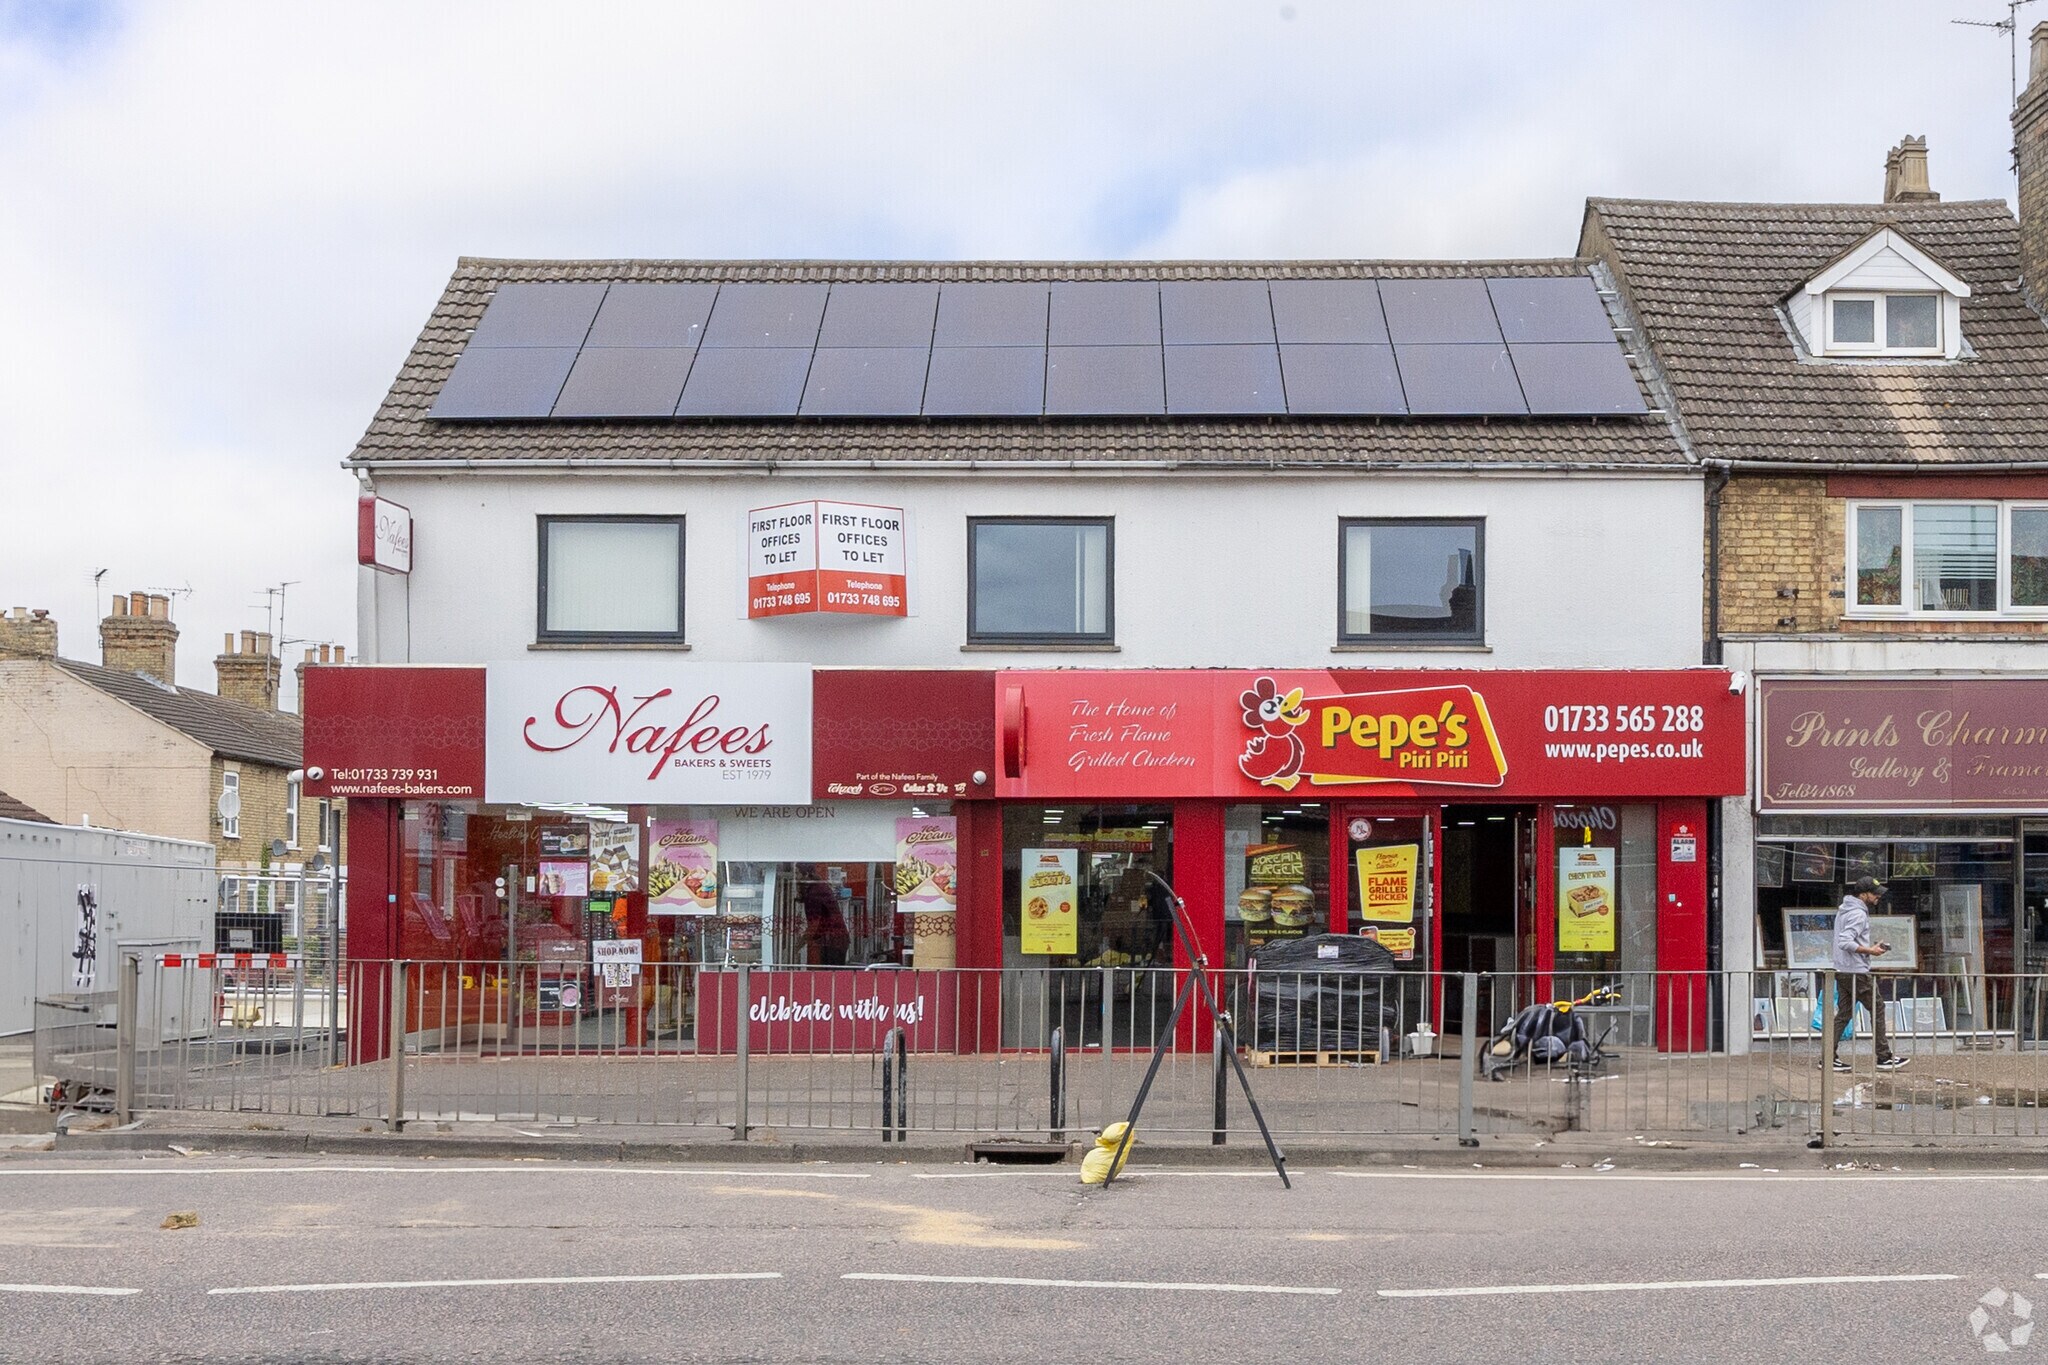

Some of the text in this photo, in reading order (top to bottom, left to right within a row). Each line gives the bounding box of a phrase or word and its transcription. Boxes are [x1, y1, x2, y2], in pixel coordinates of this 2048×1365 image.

[752, 514, 812, 533] FIRST FLOOR
[822, 514, 900, 531] FIRST FLOOR
[761, 533, 800, 548] OFFICES
[837, 532, 888, 547] OFFICES
[765, 551, 797, 565] TO LET
[842, 550, 884, 563] TO LET
[766, 582, 795, 592] Telephone
[846, 579, 883, 590] Telephone
[754, 593, 811, 609] 01733 748 695
[827, 592, 900, 607] 01733 748 695
[1070, 697, 1177, 719] The Home of
[1544, 705, 1704, 732] 01733 565 288
[523, 686, 773, 780] Nafees
[1069, 724, 1172, 742] Fresh Flame
[1322, 700, 1469, 759] Pepe's
[1786, 710, 1900, 747] Prints
[1545, 738, 1704, 763] www.pepes.co.uk
[674, 759, 771, 768] BAKERS & SWEETS
[1068, 749, 1196, 772] Grilled Chicken
[1400, 750, 1468, 768] Piri Piri
[331, 768, 438, 781] Tel:01733 739 931
[722, 770, 771, 780] EST 1979
[856, 772, 870, 780] Part
[870, 772, 879, 780] of
[879, 772, 890, 780] the
[916, 773, 938, 782] Family
[1850, 755, 2048, 787] Gallery & Frame
[331, 783, 472, 794] www.nafees-bakers.com
[735, 806, 835, 818] WE ARE OPEN
[921, 825, 940, 833] Ice
[659, 834, 708, 850] Cream
[906, 831, 954, 848] Cream
[1253, 851, 1302, 865] KOREAN
[1251, 862, 1304, 875] BURGER
[1368, 877, 1407, 886] FLAME
[1368, 893, 1408, 901] CHICKEN
[597, 945, 638, 956] SHOP NOW!
[750, 995, 924, 1024] elebrate with us!
